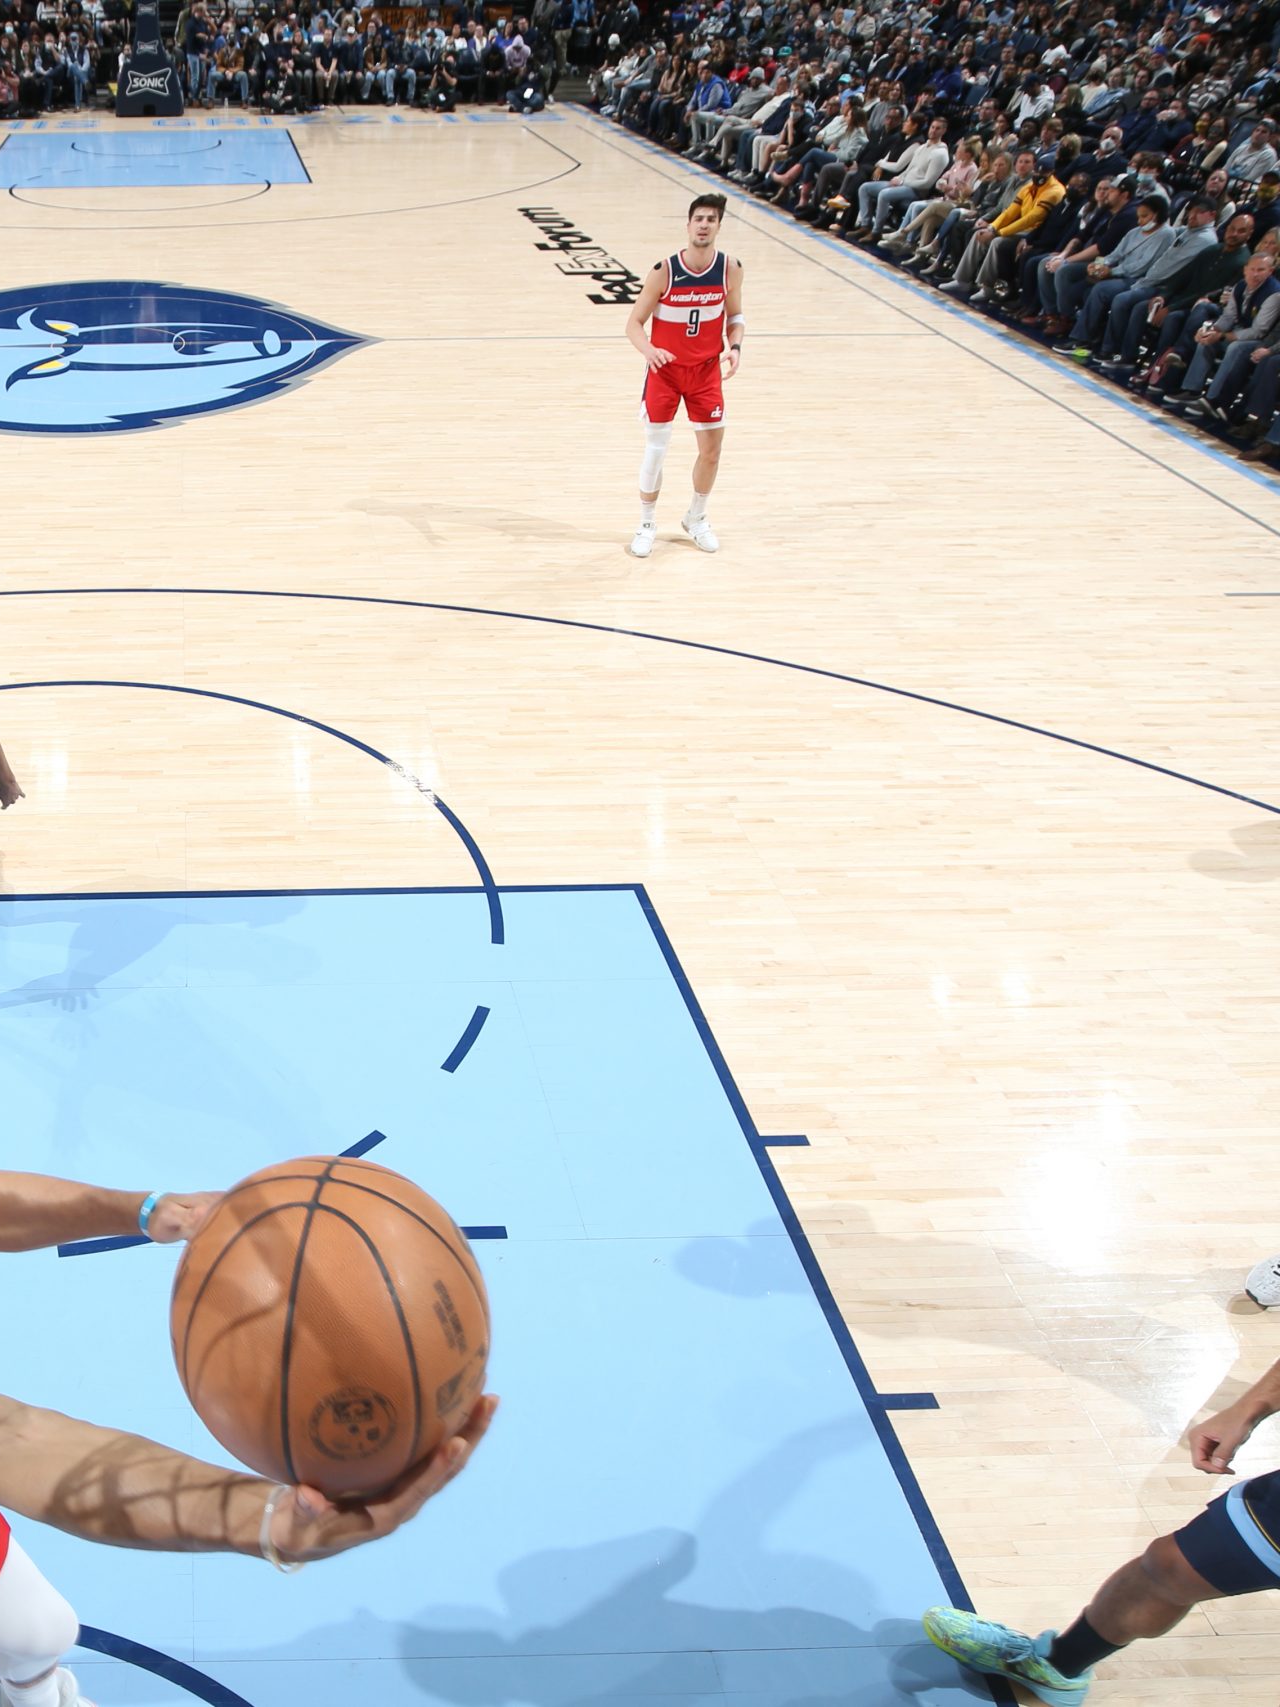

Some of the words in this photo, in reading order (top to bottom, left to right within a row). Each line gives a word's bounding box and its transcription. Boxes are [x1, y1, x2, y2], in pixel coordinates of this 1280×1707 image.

[132, 77, 165, 88] SONIC
[518, 206, 644, 305] FedExForum
[670, 290, 723, 305] washington
[685, 308, 701, 337] 9
